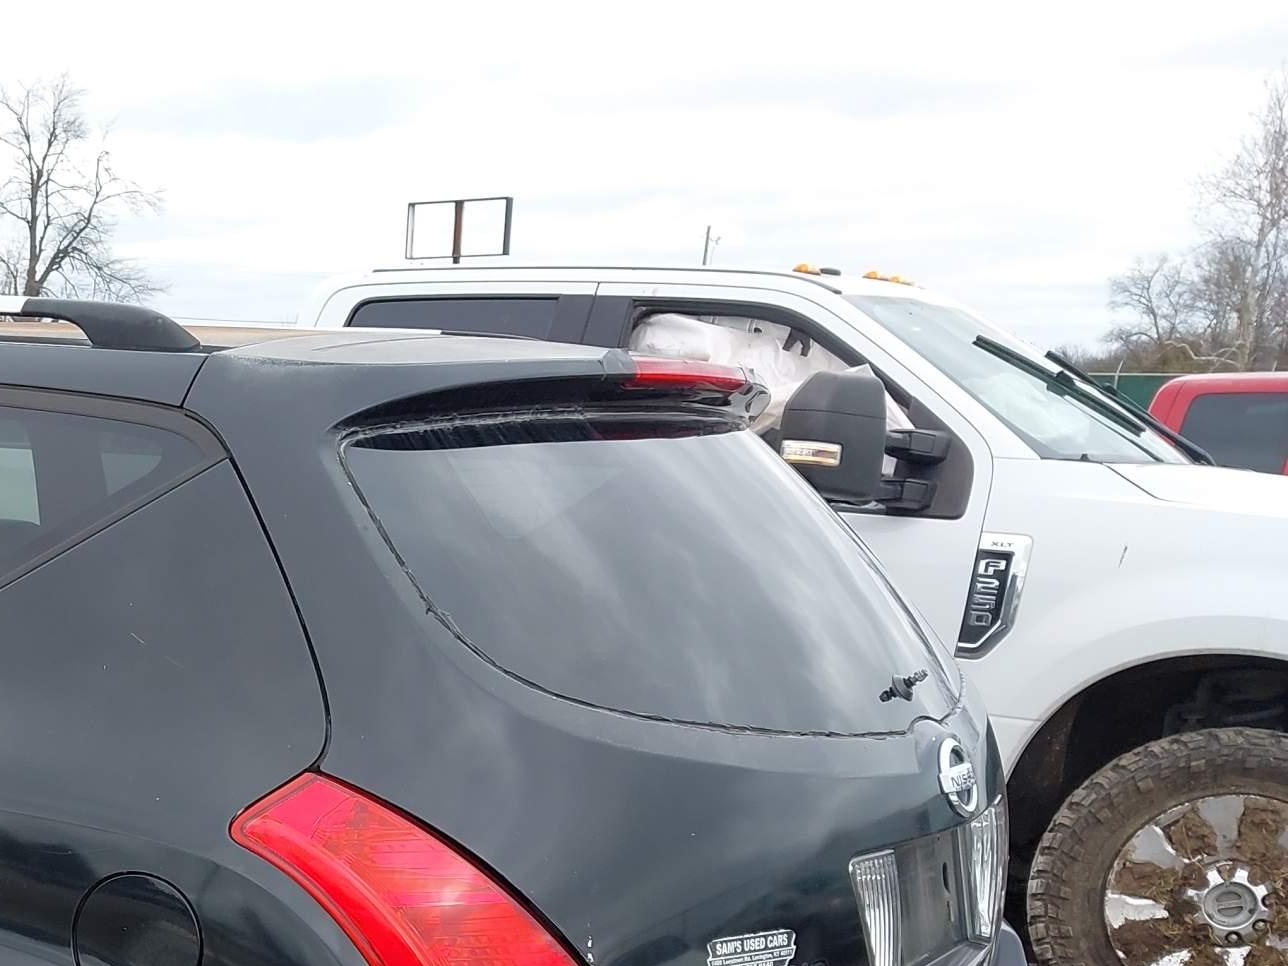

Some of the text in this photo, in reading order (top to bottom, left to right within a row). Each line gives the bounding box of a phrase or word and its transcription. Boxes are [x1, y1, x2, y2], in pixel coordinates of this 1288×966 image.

[716, 933, 789, 955] SAM'S USED CARS
